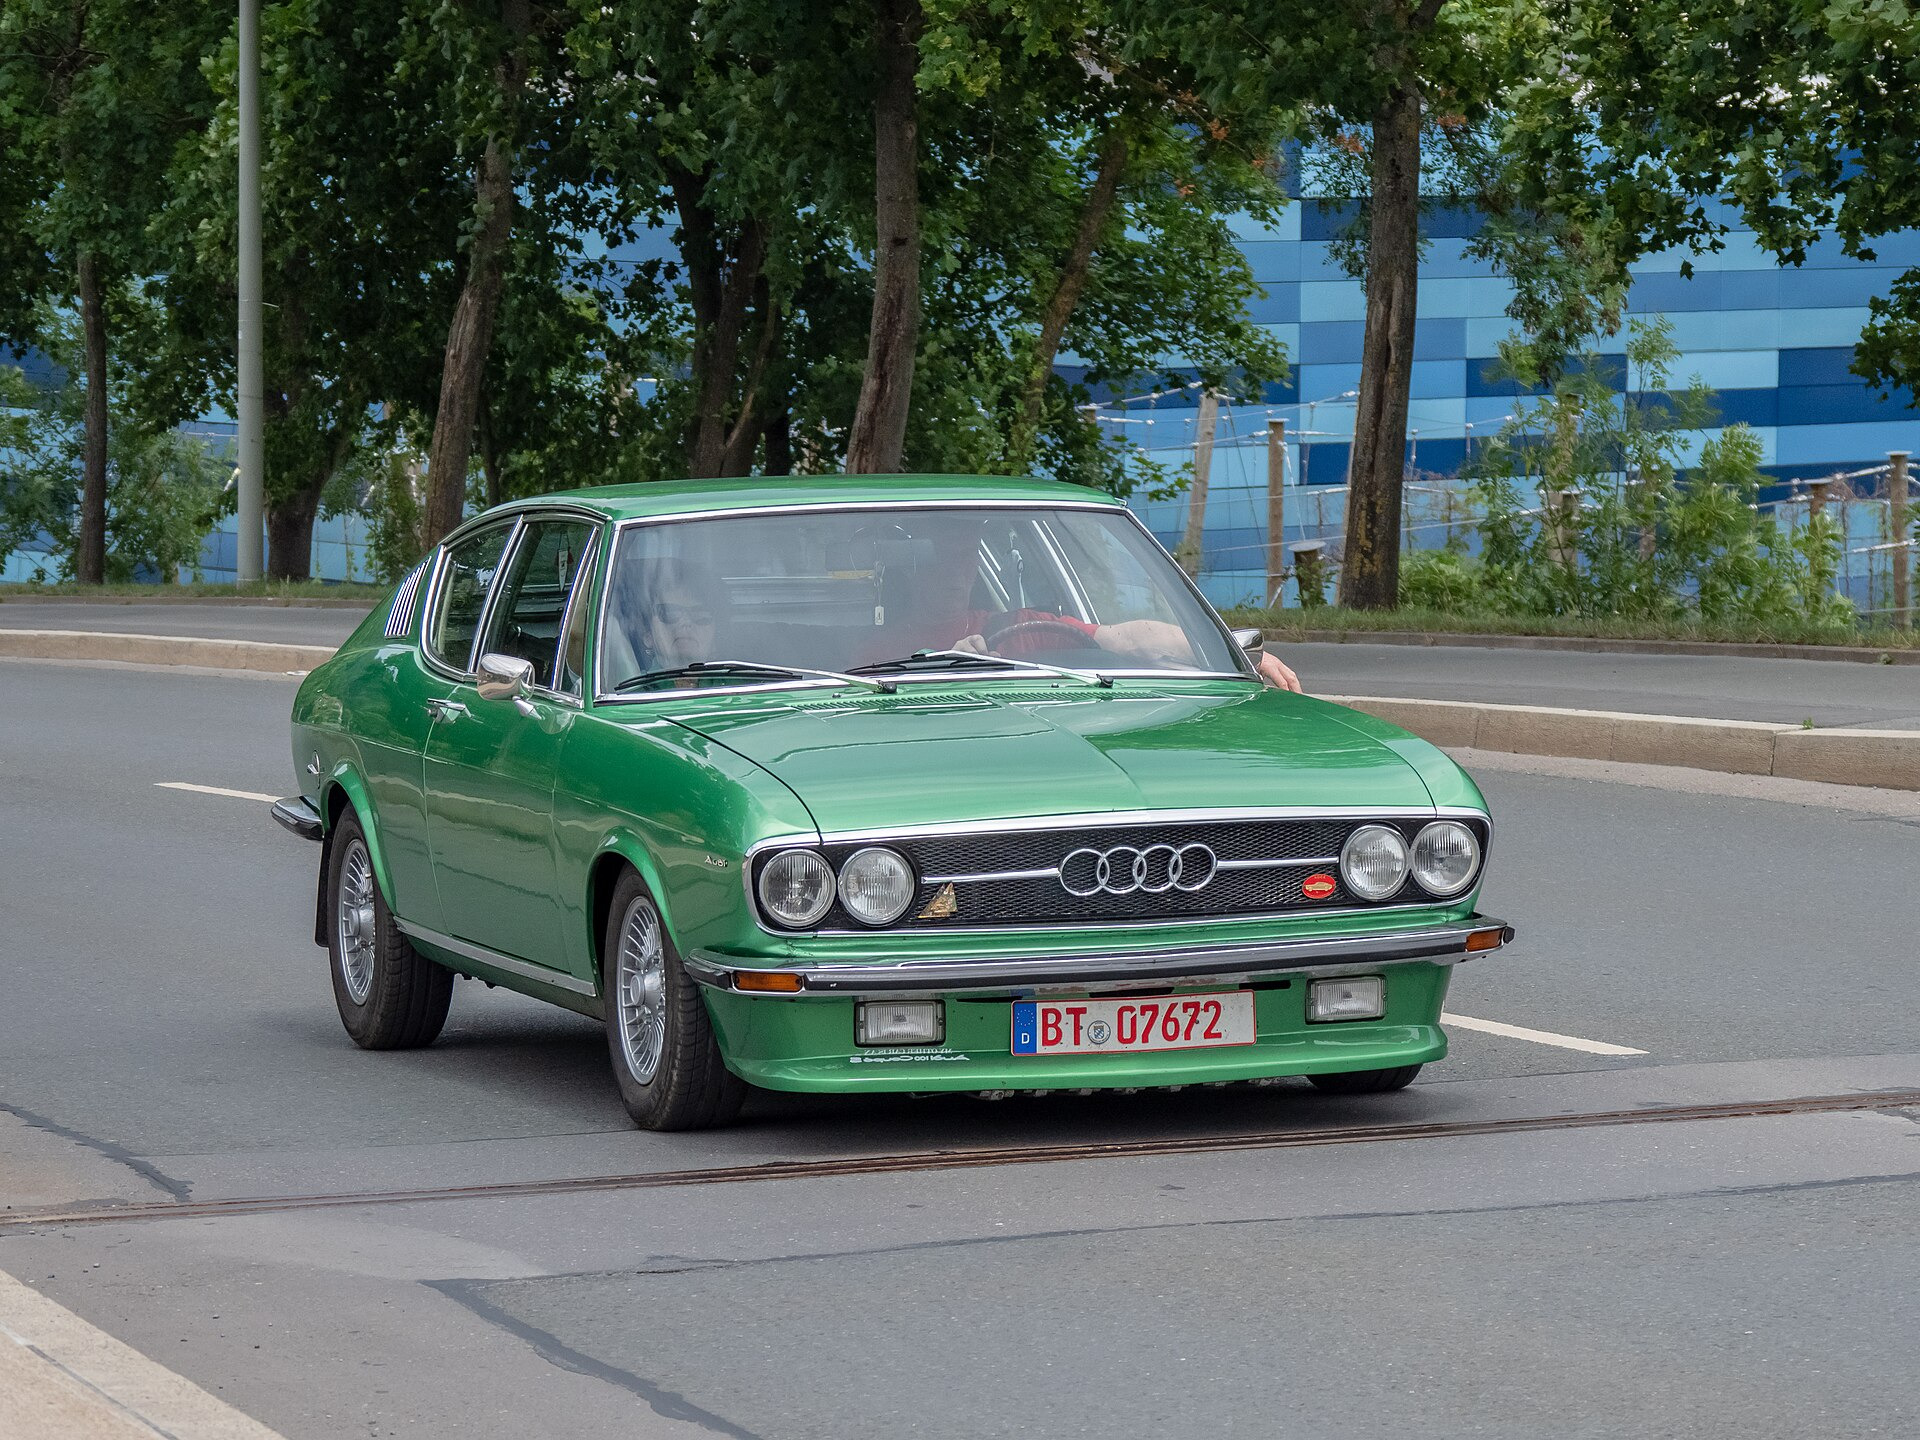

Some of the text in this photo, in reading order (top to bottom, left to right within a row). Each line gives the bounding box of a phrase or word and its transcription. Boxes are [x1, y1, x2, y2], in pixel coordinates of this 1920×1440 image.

[1041, 1007, 1087, 1046] BT
[1117, 1000, 1222, 1045] 07672
[1021, 1032, 1030, 1044] D
